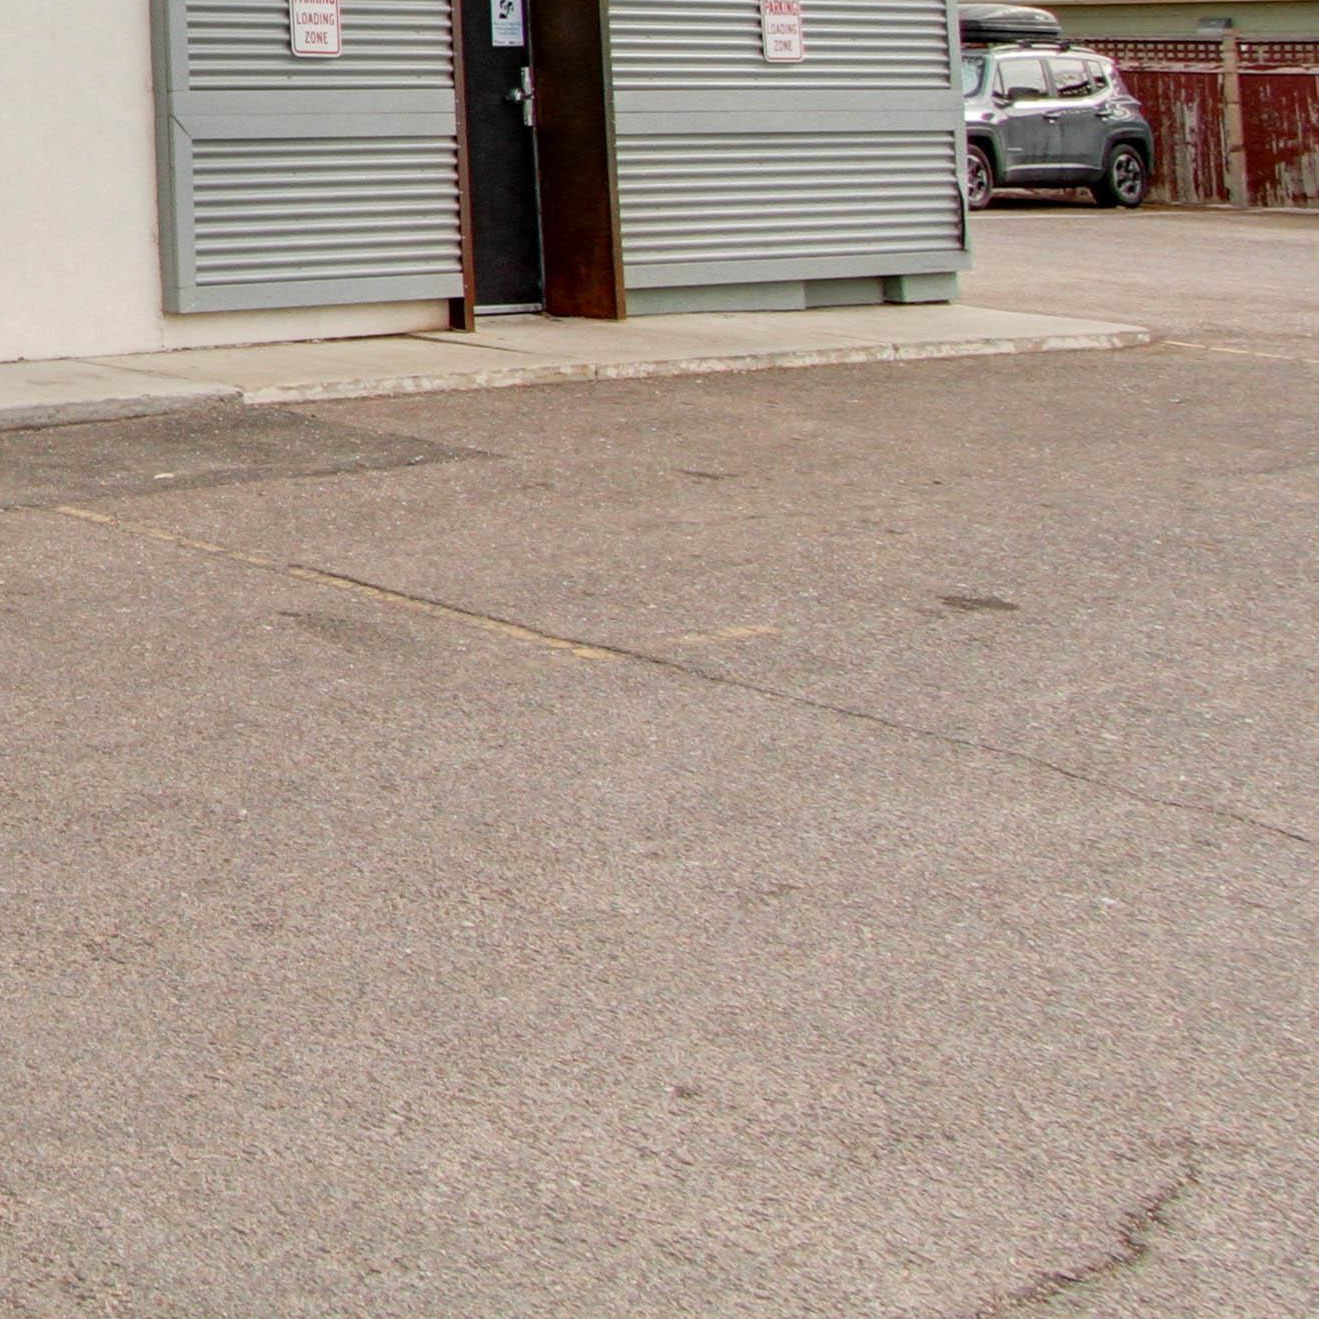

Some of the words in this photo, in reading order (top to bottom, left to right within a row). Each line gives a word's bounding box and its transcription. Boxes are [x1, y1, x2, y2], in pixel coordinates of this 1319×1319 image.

[763, 0, 798, 15] PARKING
[296, 12, 335, 26] LOADING
[304, 31, 328, 45] ZONE
